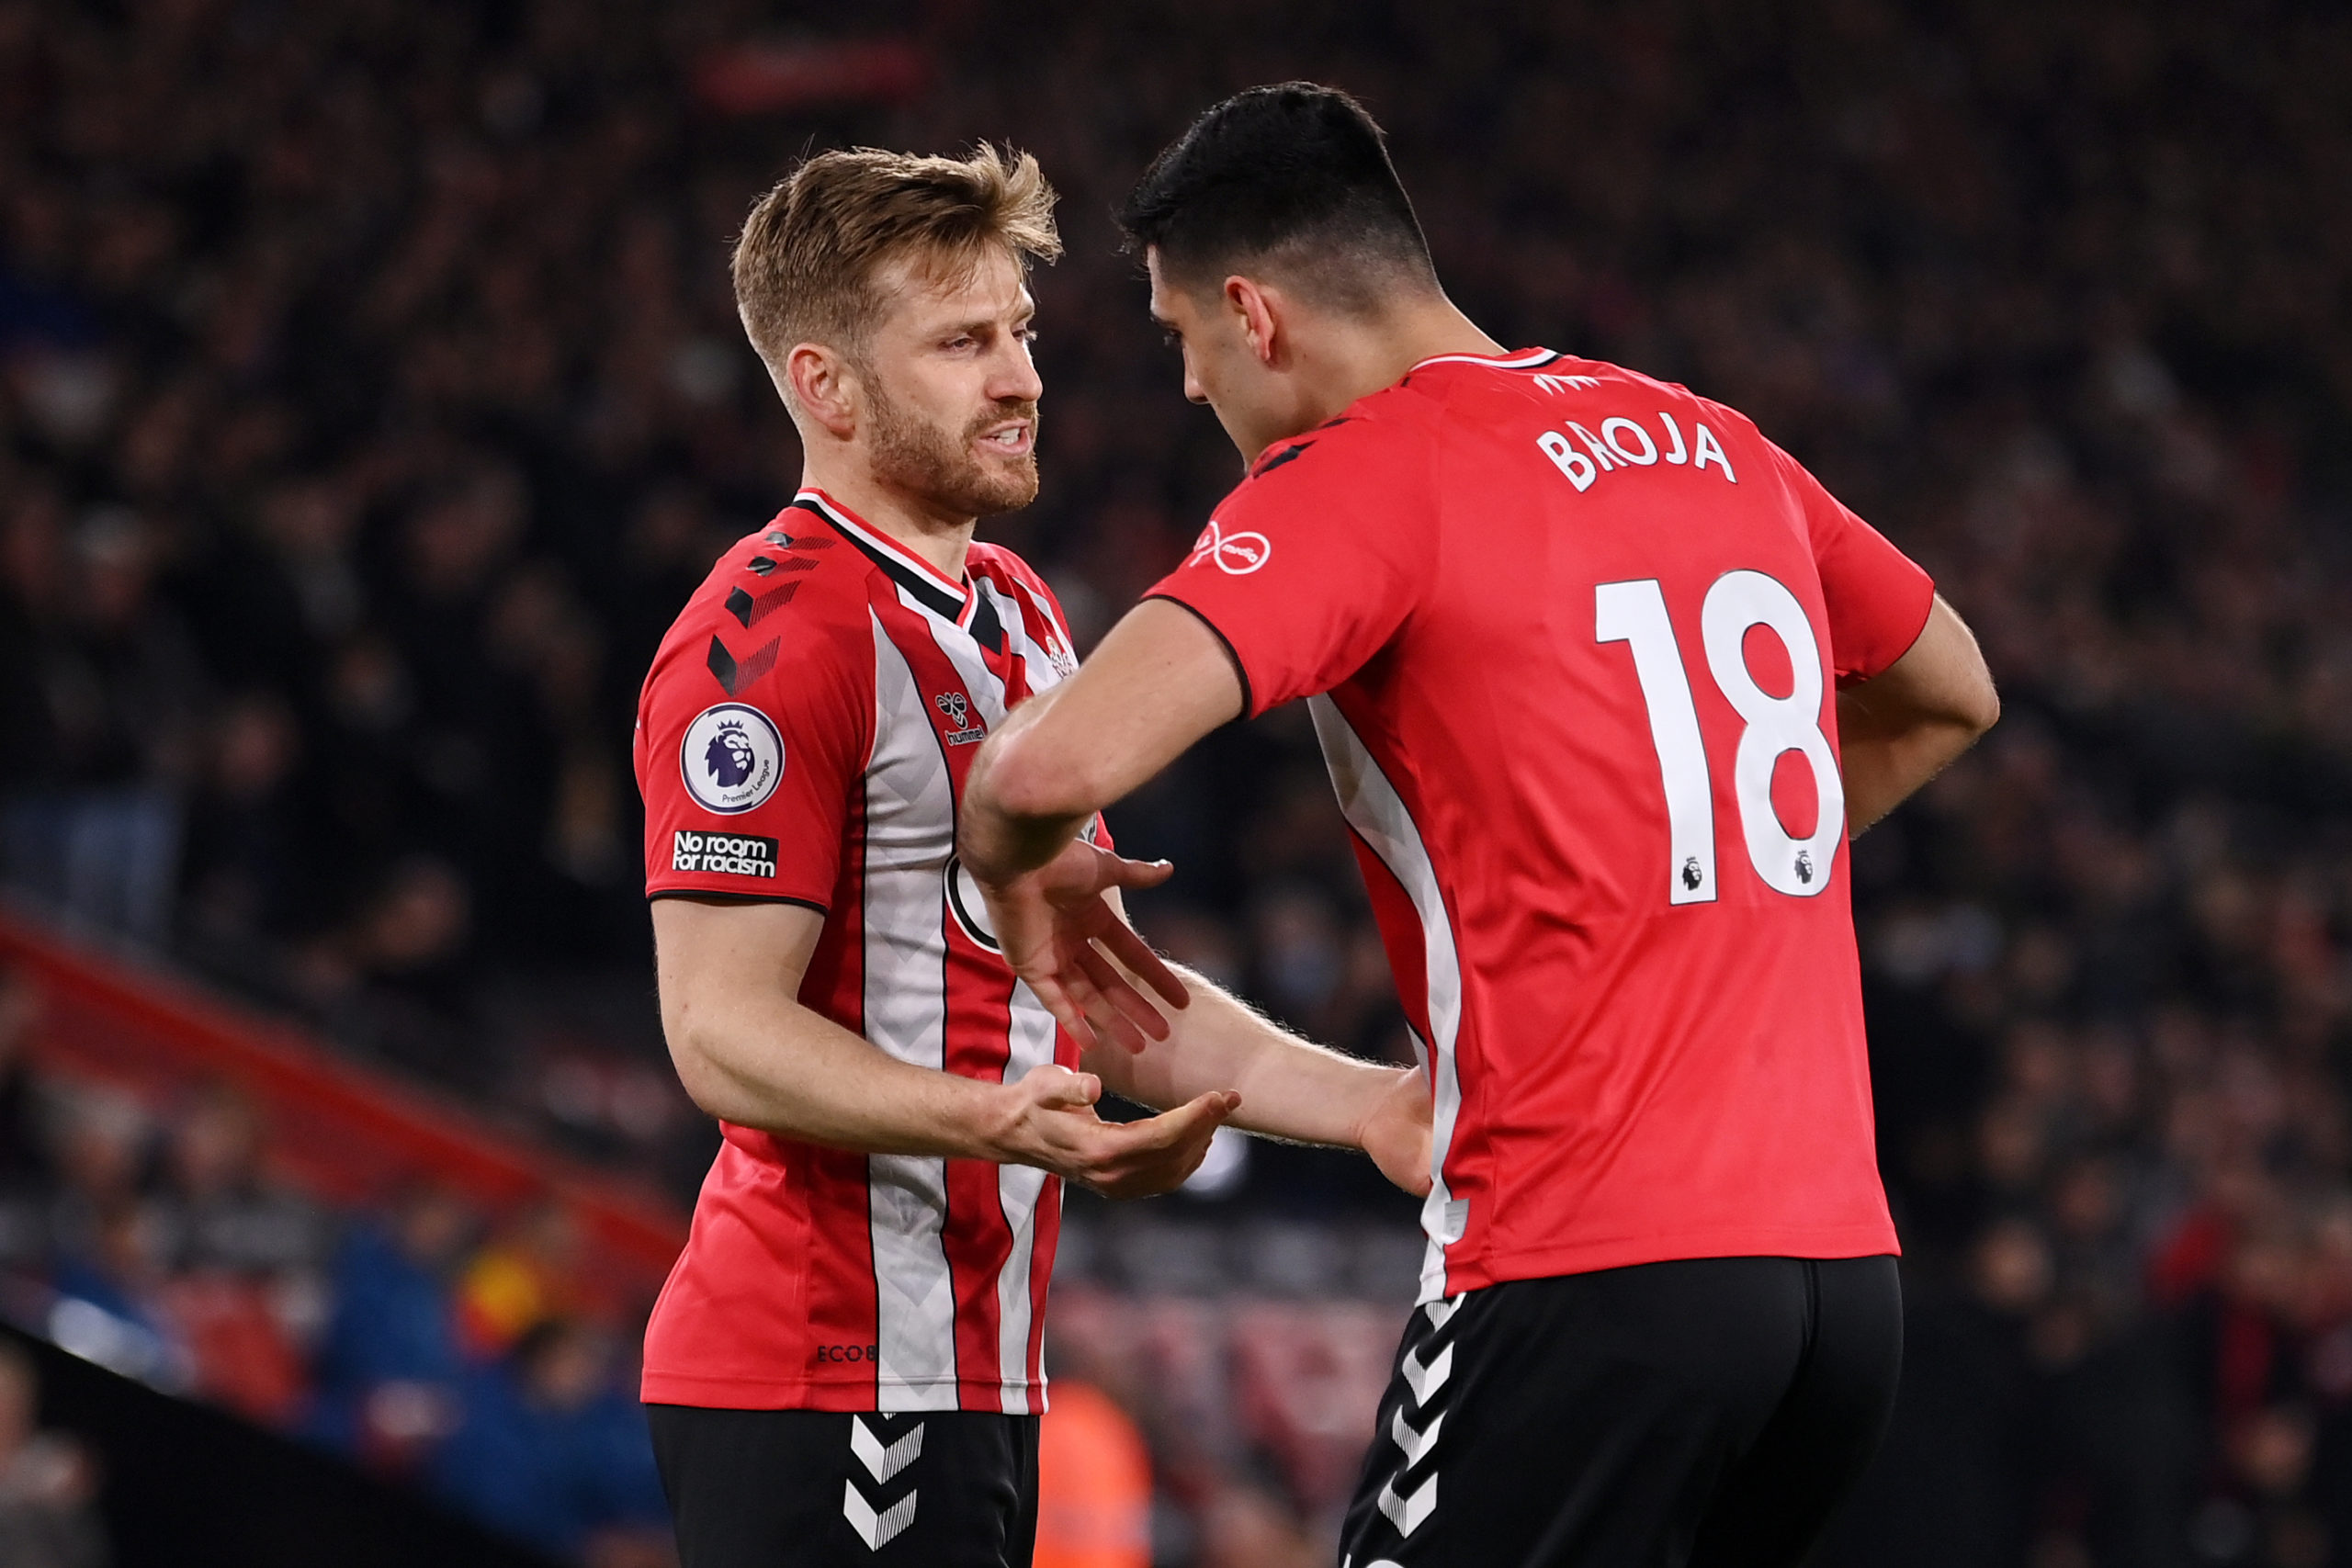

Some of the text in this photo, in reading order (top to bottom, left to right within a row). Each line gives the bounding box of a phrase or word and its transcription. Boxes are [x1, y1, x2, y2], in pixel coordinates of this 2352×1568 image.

[1536, 412, 1738, 493] BROJA
[944, 724, 986, 746] hummel
[1595, 569, 1845, 906] 18
[722, 759, 770, 802] Premier League
[673, 831, 767, 859] No room
[672, 850, 775, 877] for racism
